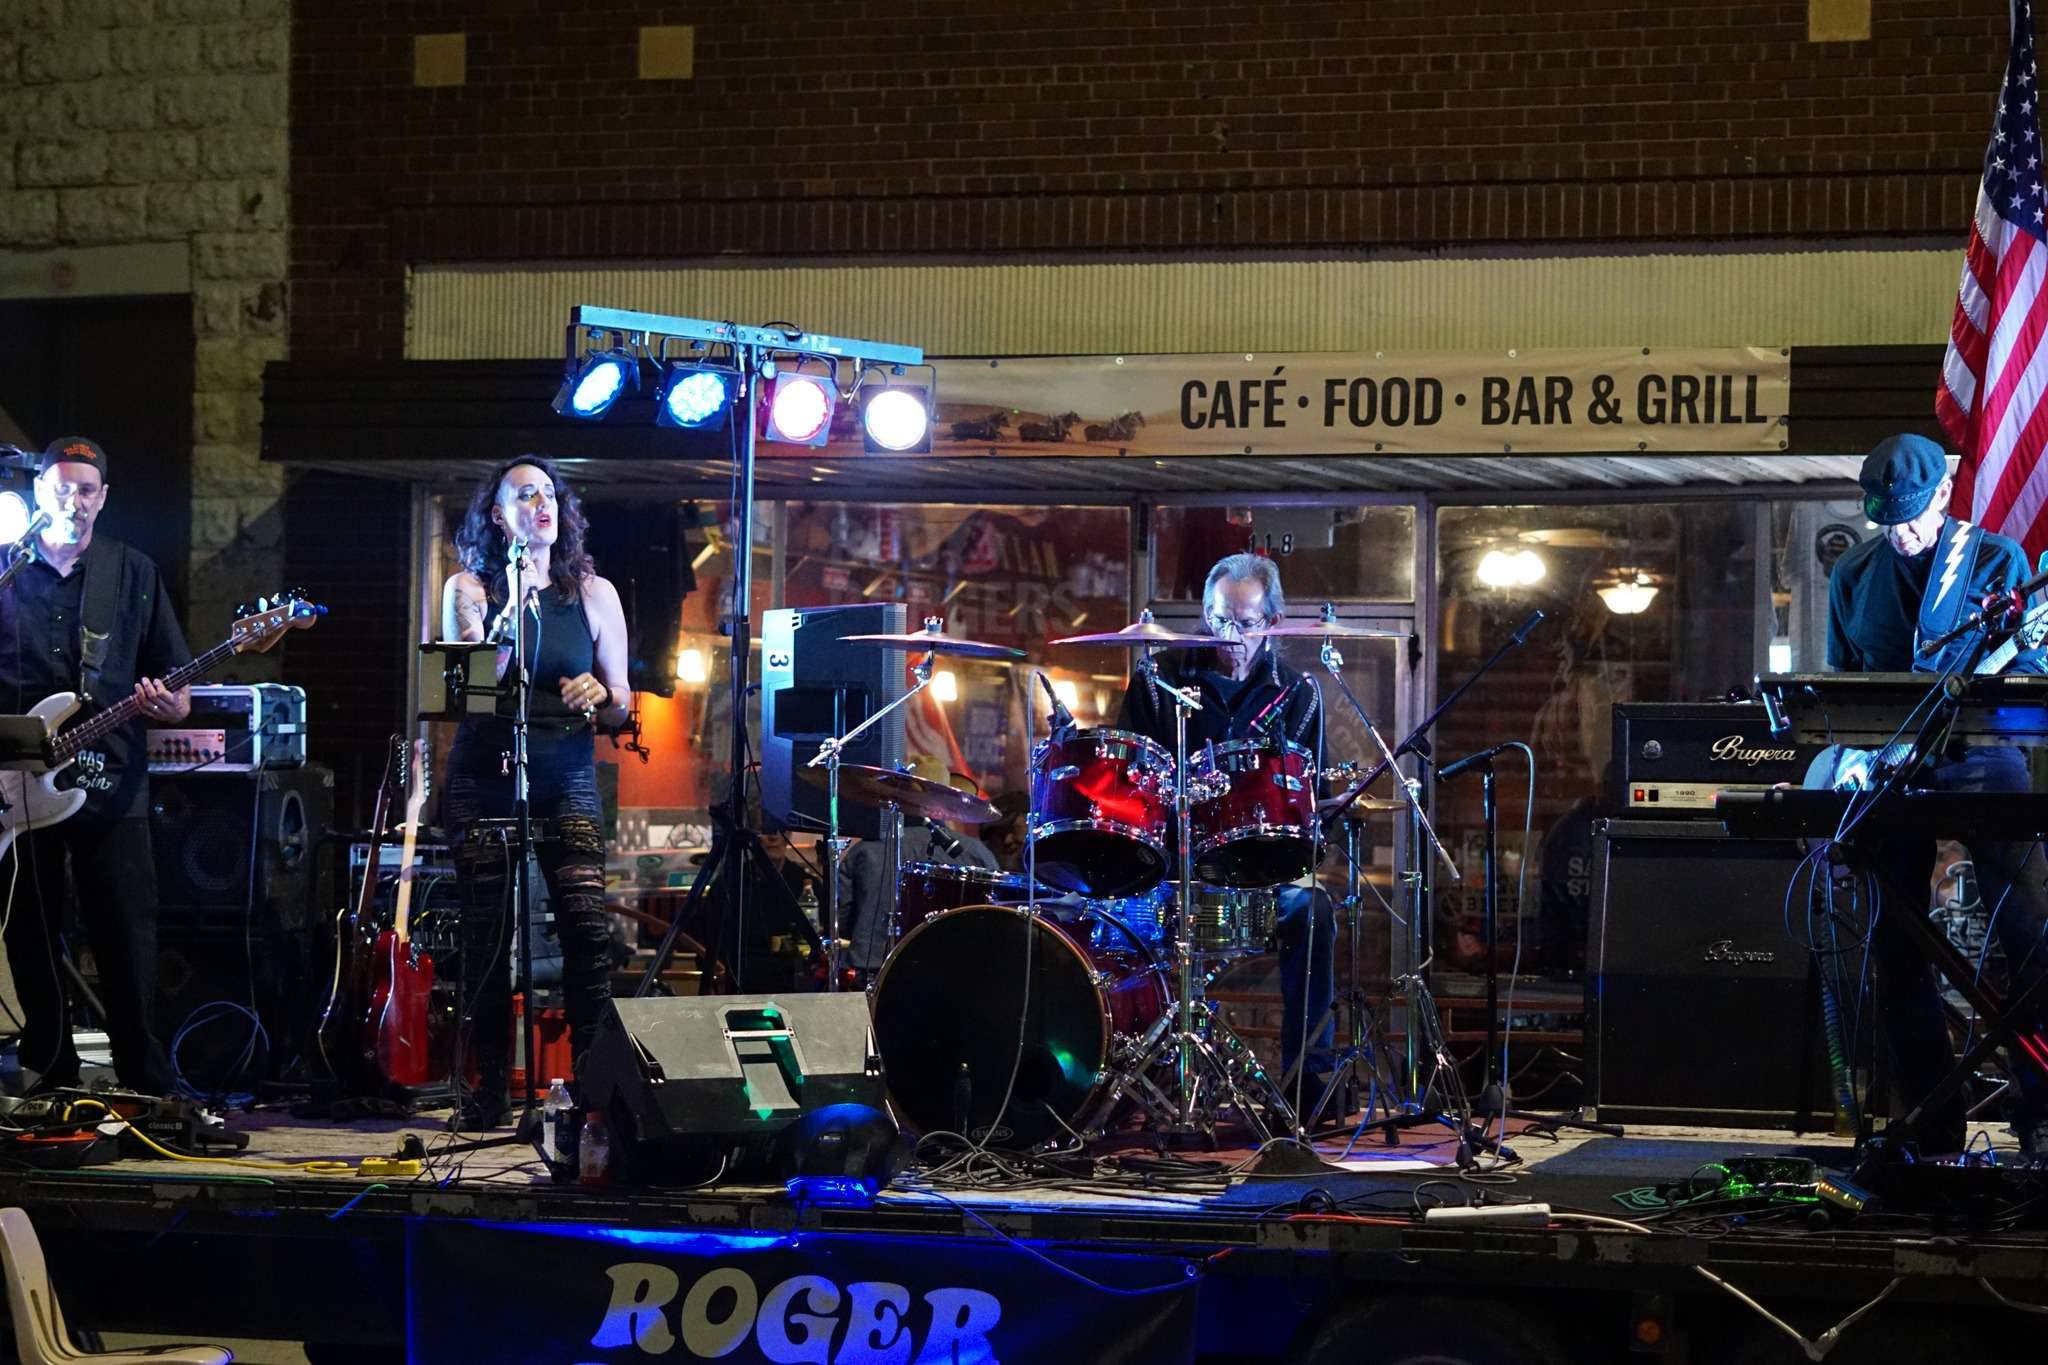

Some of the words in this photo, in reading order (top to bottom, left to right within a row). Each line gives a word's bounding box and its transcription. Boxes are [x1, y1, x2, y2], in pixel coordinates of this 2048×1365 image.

[1181, 366, 1287, 430] CAFÉ
[1324, 376, 1443, 427] FOOD
[1482, 375, 1573, 425] BAR
[1588, 374, 1623, 425] &
[1638, 373, 1768, 425] GRILL
[1248, 532, 1294, 556] 118
[1709, 734, 1797, 767] Bugera
[590, 1262, 1001, 1365] ROGER
